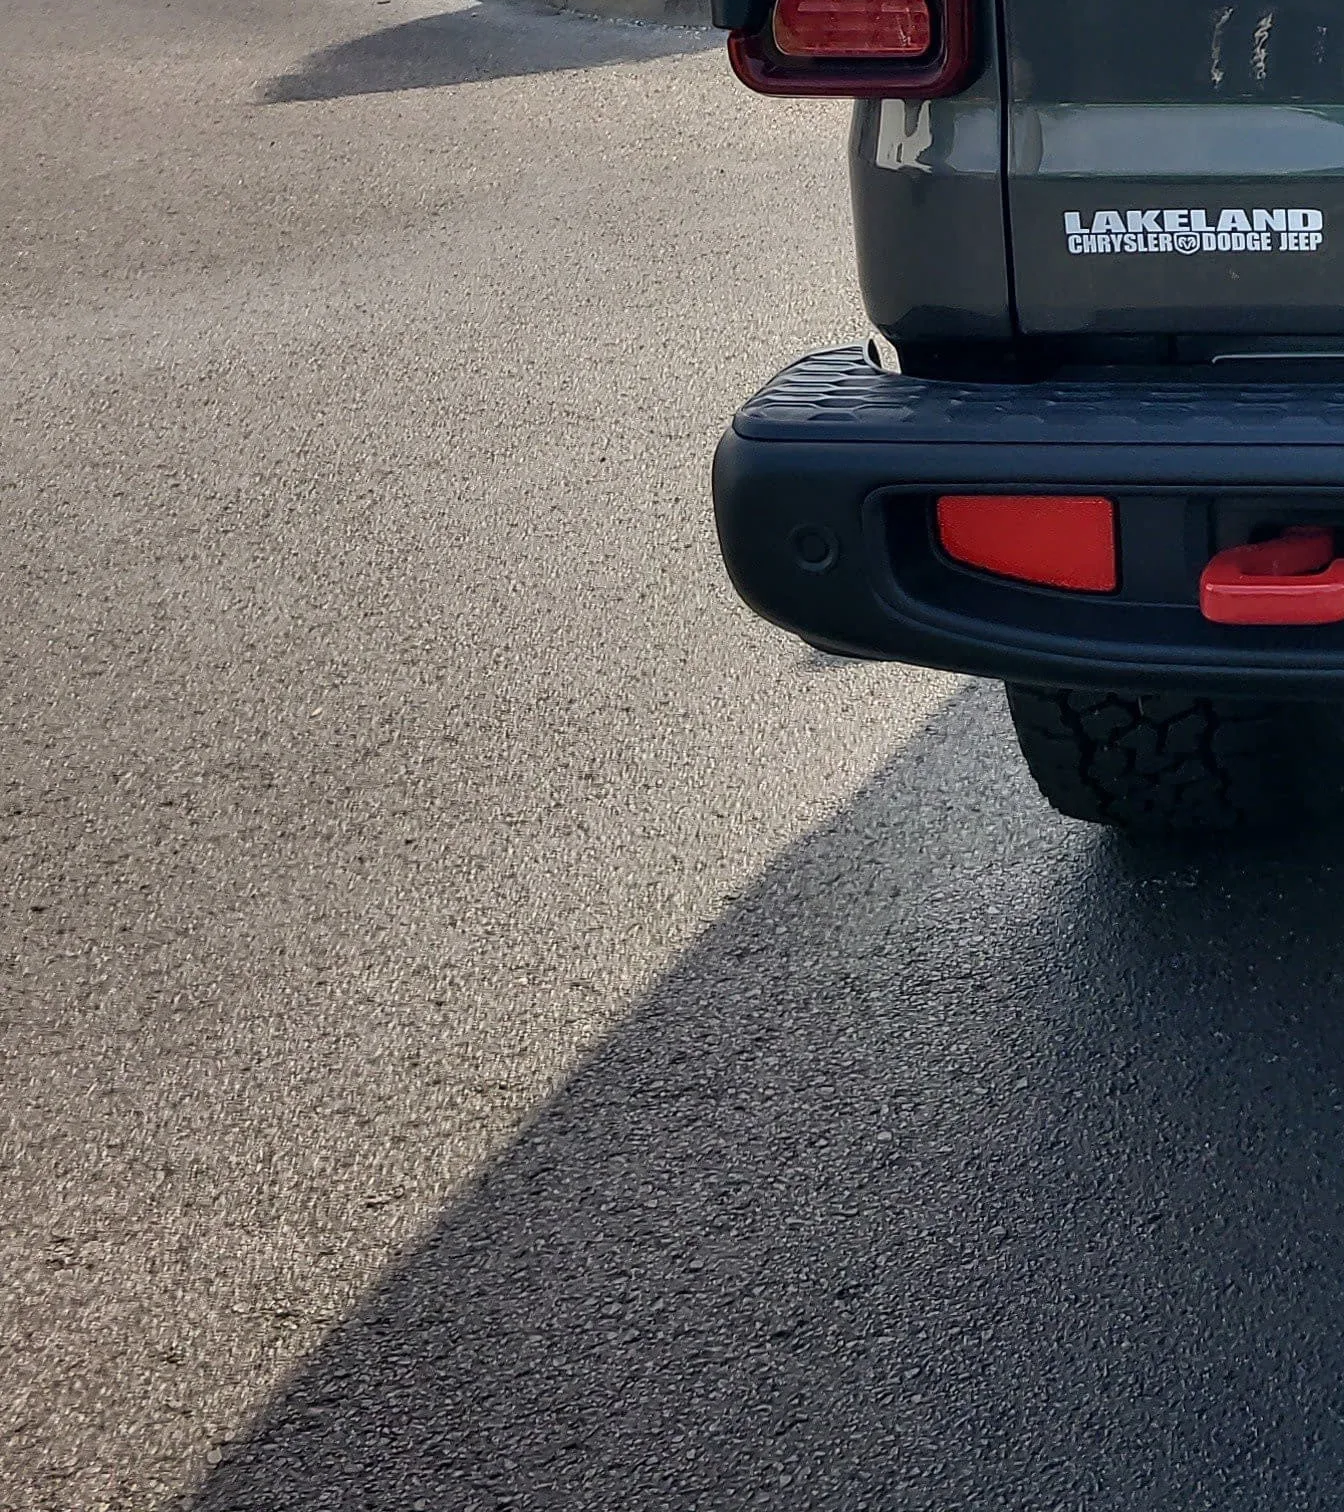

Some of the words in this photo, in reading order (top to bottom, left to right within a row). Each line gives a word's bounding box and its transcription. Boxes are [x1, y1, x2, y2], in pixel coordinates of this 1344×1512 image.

[1064, 208, 1323, 234] LAKELAND
[1067, 233, 1173, 254] CHRYSLER
[1202, 232, 1272, 252] DODGE
[1278, 232, 1323, 251] JEEP
